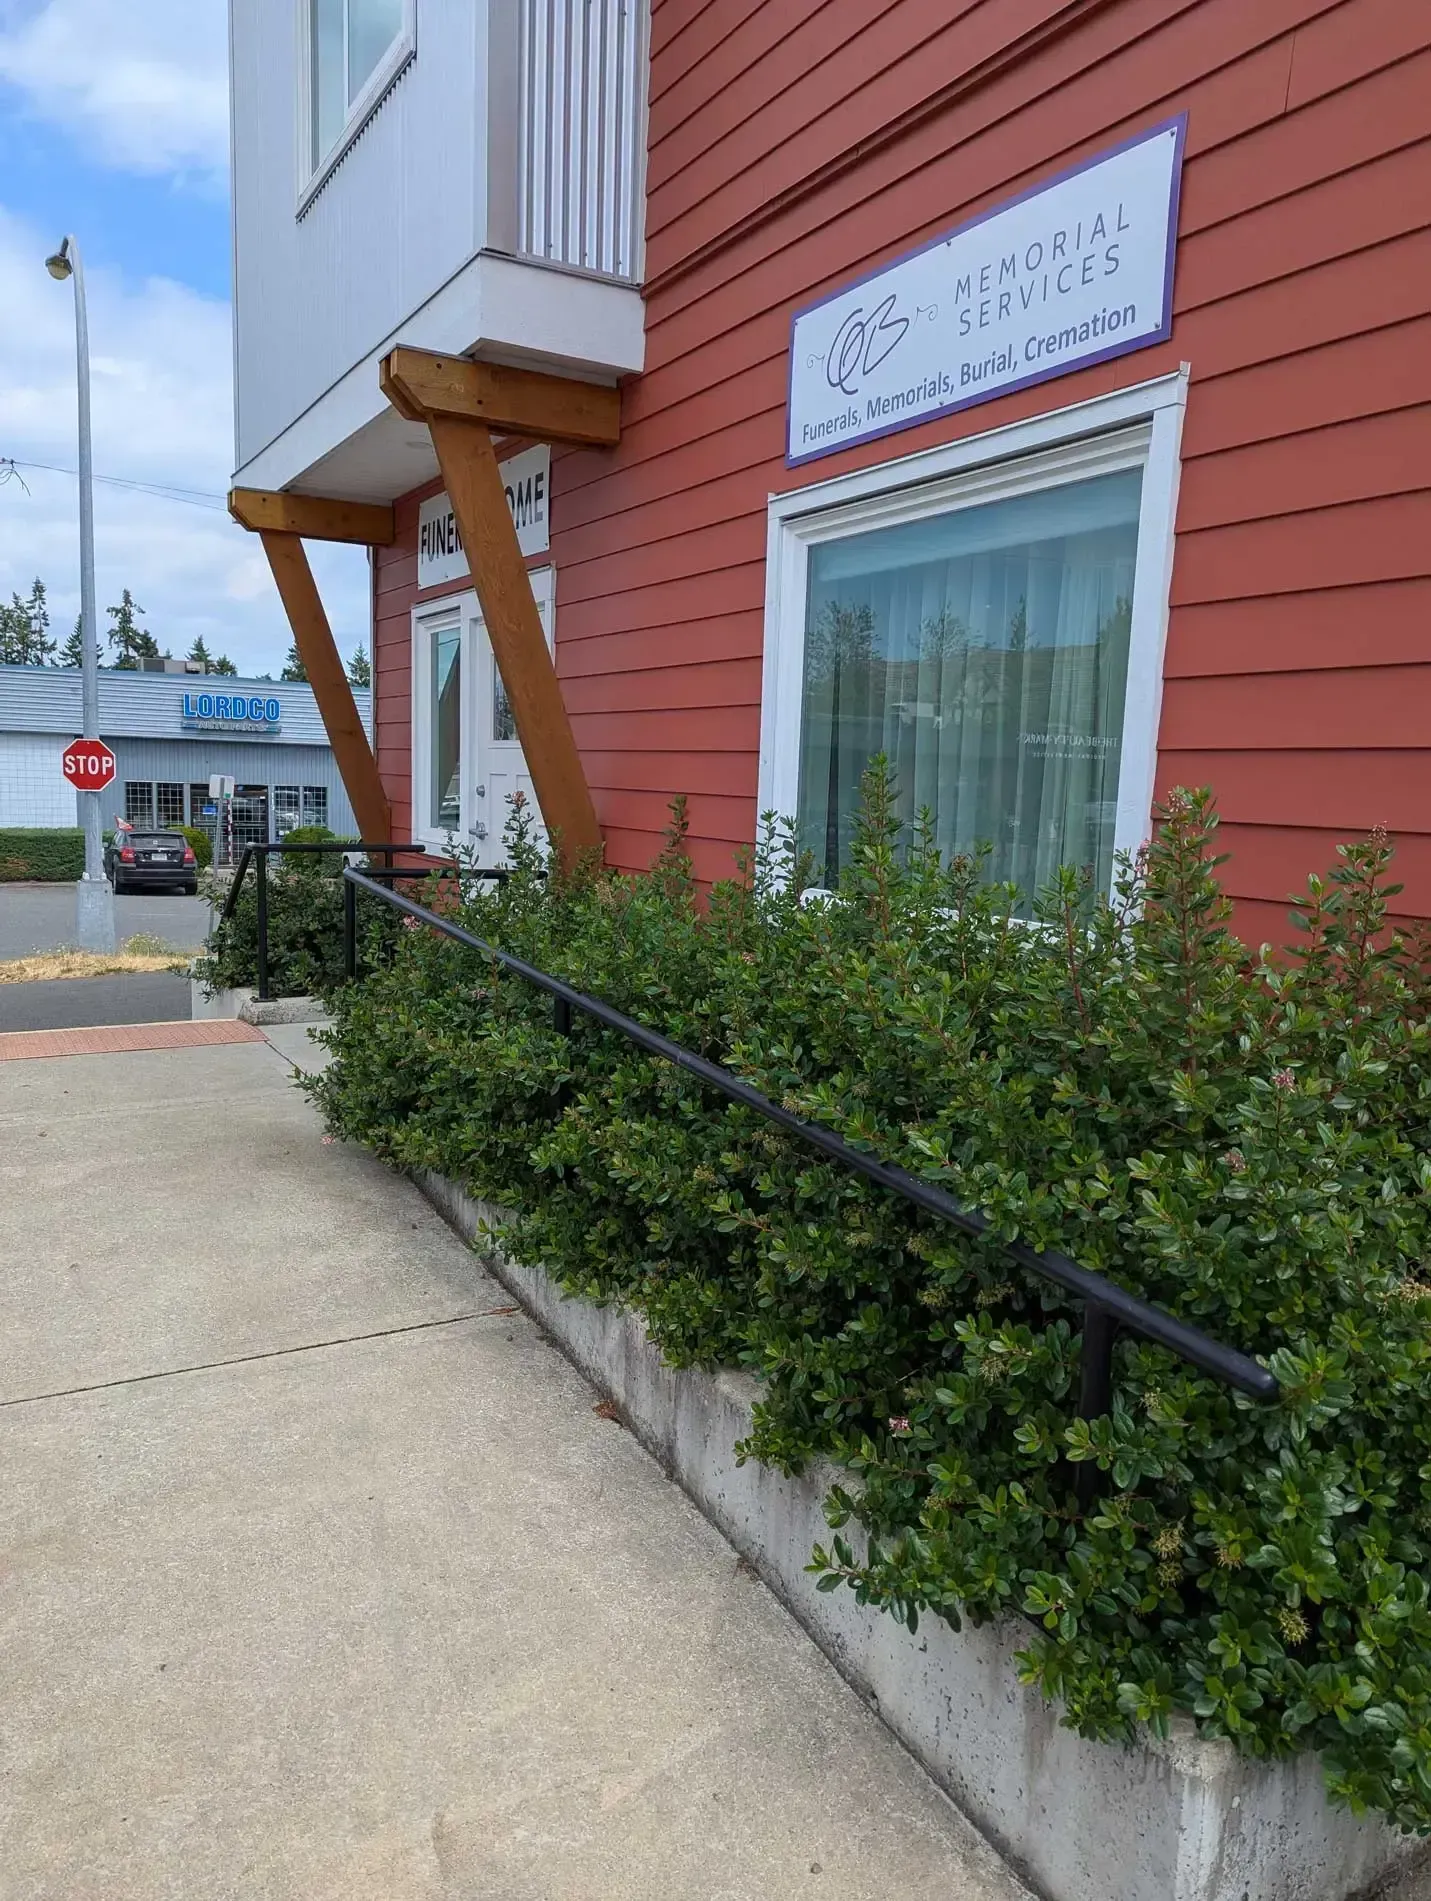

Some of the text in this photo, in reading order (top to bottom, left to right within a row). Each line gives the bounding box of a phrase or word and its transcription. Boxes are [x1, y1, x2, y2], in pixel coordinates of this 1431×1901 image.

[955, 203, 1130, 305] MEMORIAL
[959, 243, 1120, 336] SERVICES
[802, 303, 1136, 444] Funerals, Memorials, Burial, Cremation
[420, 472, 544, 565] FUNE OME
[183, 692, 281, 722] LORDCO
[64, 754, 113, 776] STOP
